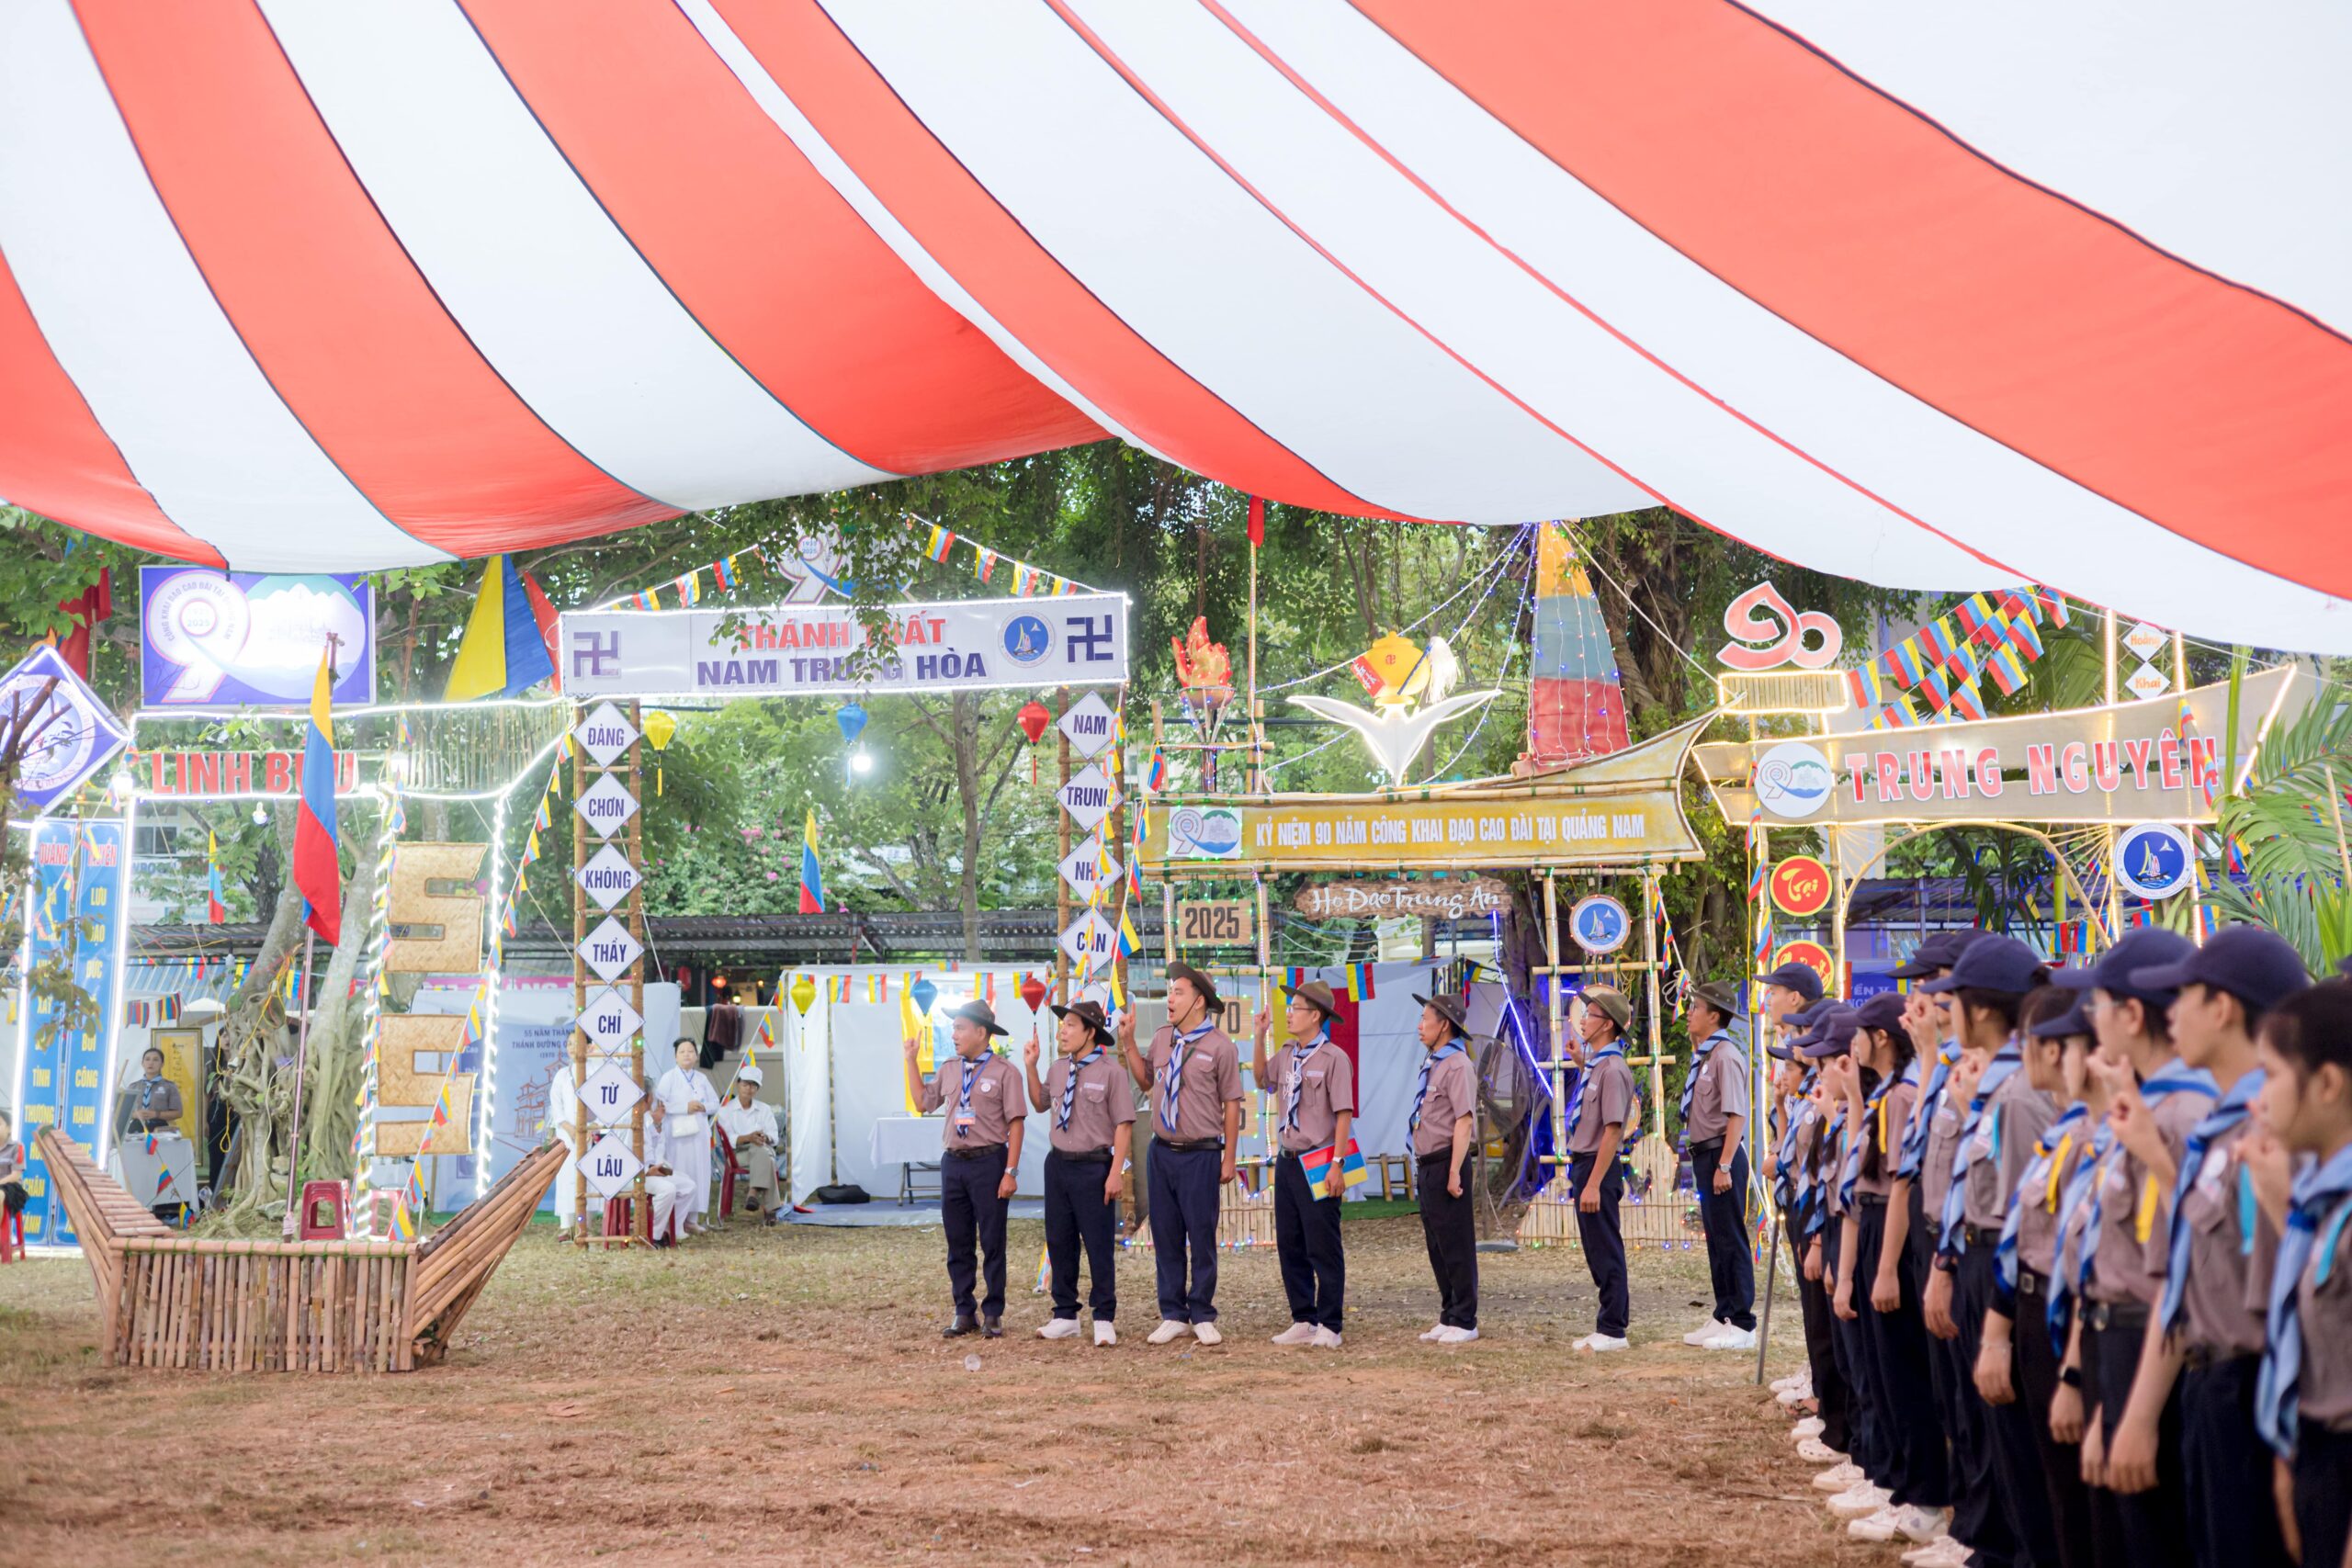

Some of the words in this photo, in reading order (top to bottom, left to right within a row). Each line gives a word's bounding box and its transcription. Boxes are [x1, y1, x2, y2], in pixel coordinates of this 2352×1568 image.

[735, 618, 849, 650] THÁNH
[696, 658, 778, 686] NAM
[916, 647, 987, 681] HÒA
[2134, 676, 2162, 690] Khai
[1073, 714, 1107, 736] NAM
[151, 751, 253, 795] LINH
[265, 751, 357, 795] BU
[1844, 747, 2004, 804] TRUNG
[2026, 727, 2219, 796] NGUYÊN
[588, 796, 625, 818] CHƠN
[1256, 815, 1273, 847] KỶ
[1278, 817, 1311, 850] NIỆM
[1315, 822, 1331, 845] 90
[1336, 815, 1367, 845] NĂM
[1371, 815, 1407, 844] CÔNG
[1411, 818, 1443, 843] KHAI
[1448, 818, 1475, 846] ĐẠO
[1479, 818, 1506, 842] CAO
[1510, 812, 1533, 841] ĐÀI
[1536, 816, 1557, 845] TẠI
[1562, 808, 1607, 842] QUẢNG
[1612, 814, 1645, 839] NAM
[585, 866, 631, 889] KHÔNG
[1781, 867, 1819, 902] Trại
[1389, 886, 1464, 919] Trung
[1470, 886, 1500, 911] An
[89, 923, 106, 947] ẠO
[1184, 906, 1240, 940] 2025
[1076, 931, 1107, 953] CN
[598, 1009, 622, 1034] CHỈ
[600, 1081, 619, 1105] TỪ
[596, 1154, 623, 1178] LÂU
